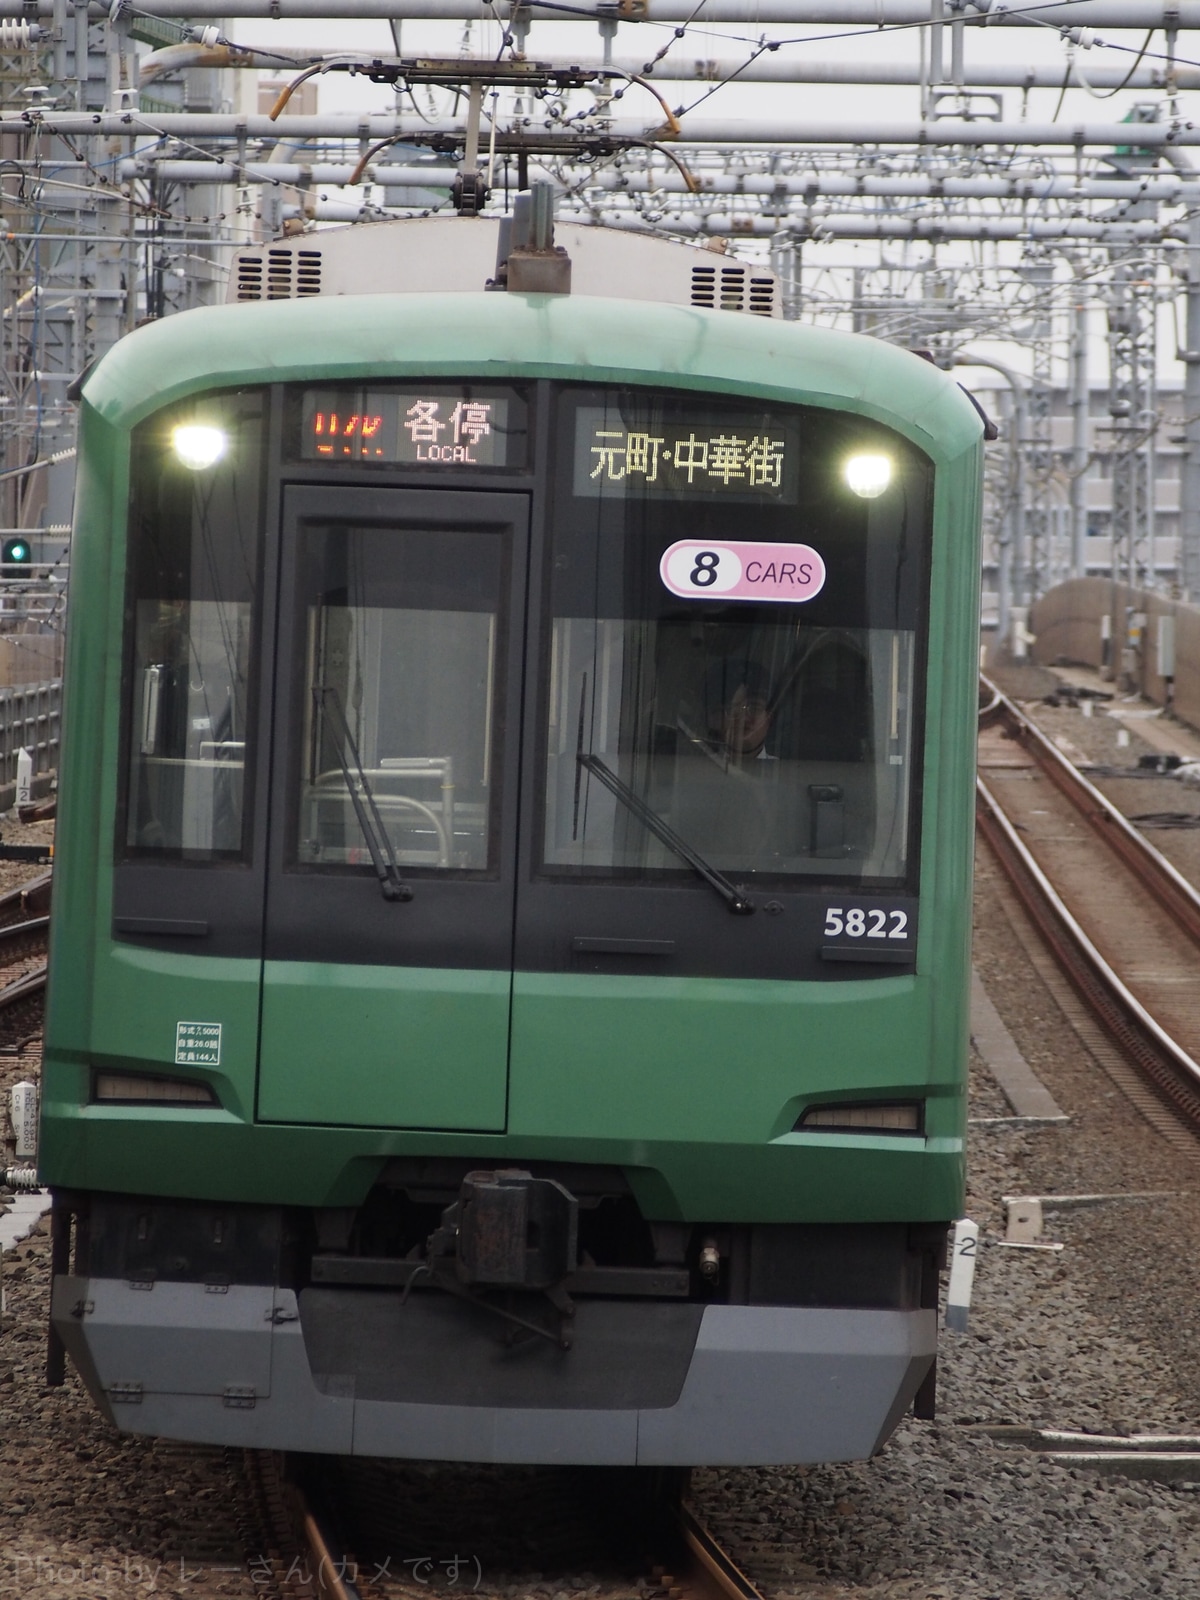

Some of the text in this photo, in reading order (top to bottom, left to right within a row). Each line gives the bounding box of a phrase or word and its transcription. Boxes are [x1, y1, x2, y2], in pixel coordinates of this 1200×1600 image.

[404, 400, 491, 444] 各停
[416, 444, 477, 463] LOCAL
[589, 431, 785, 487] 元町・中華街
[689, 551, 813, 587] 8 CARS
[823, 907, 908, 939] 5822
